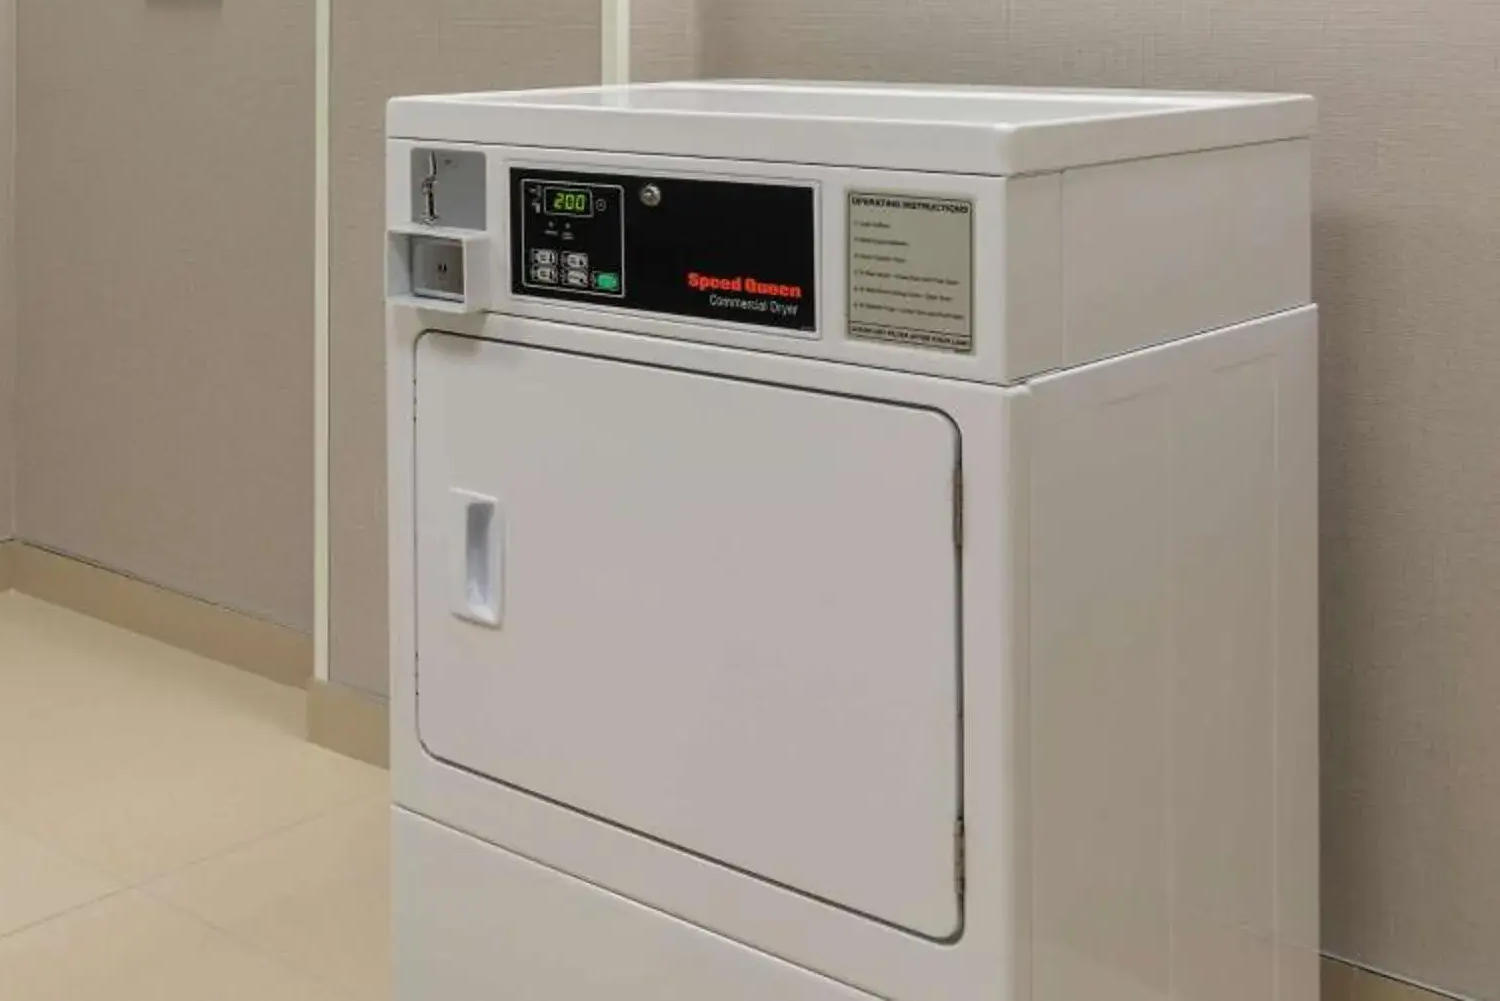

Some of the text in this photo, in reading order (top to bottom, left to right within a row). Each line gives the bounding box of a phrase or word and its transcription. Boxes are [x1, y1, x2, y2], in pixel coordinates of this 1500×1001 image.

[554, 193, 586, 211] 200
[687, 272, 803, 298] Speed Queen
[709, 293, 800, 316] Commercial Dryer
